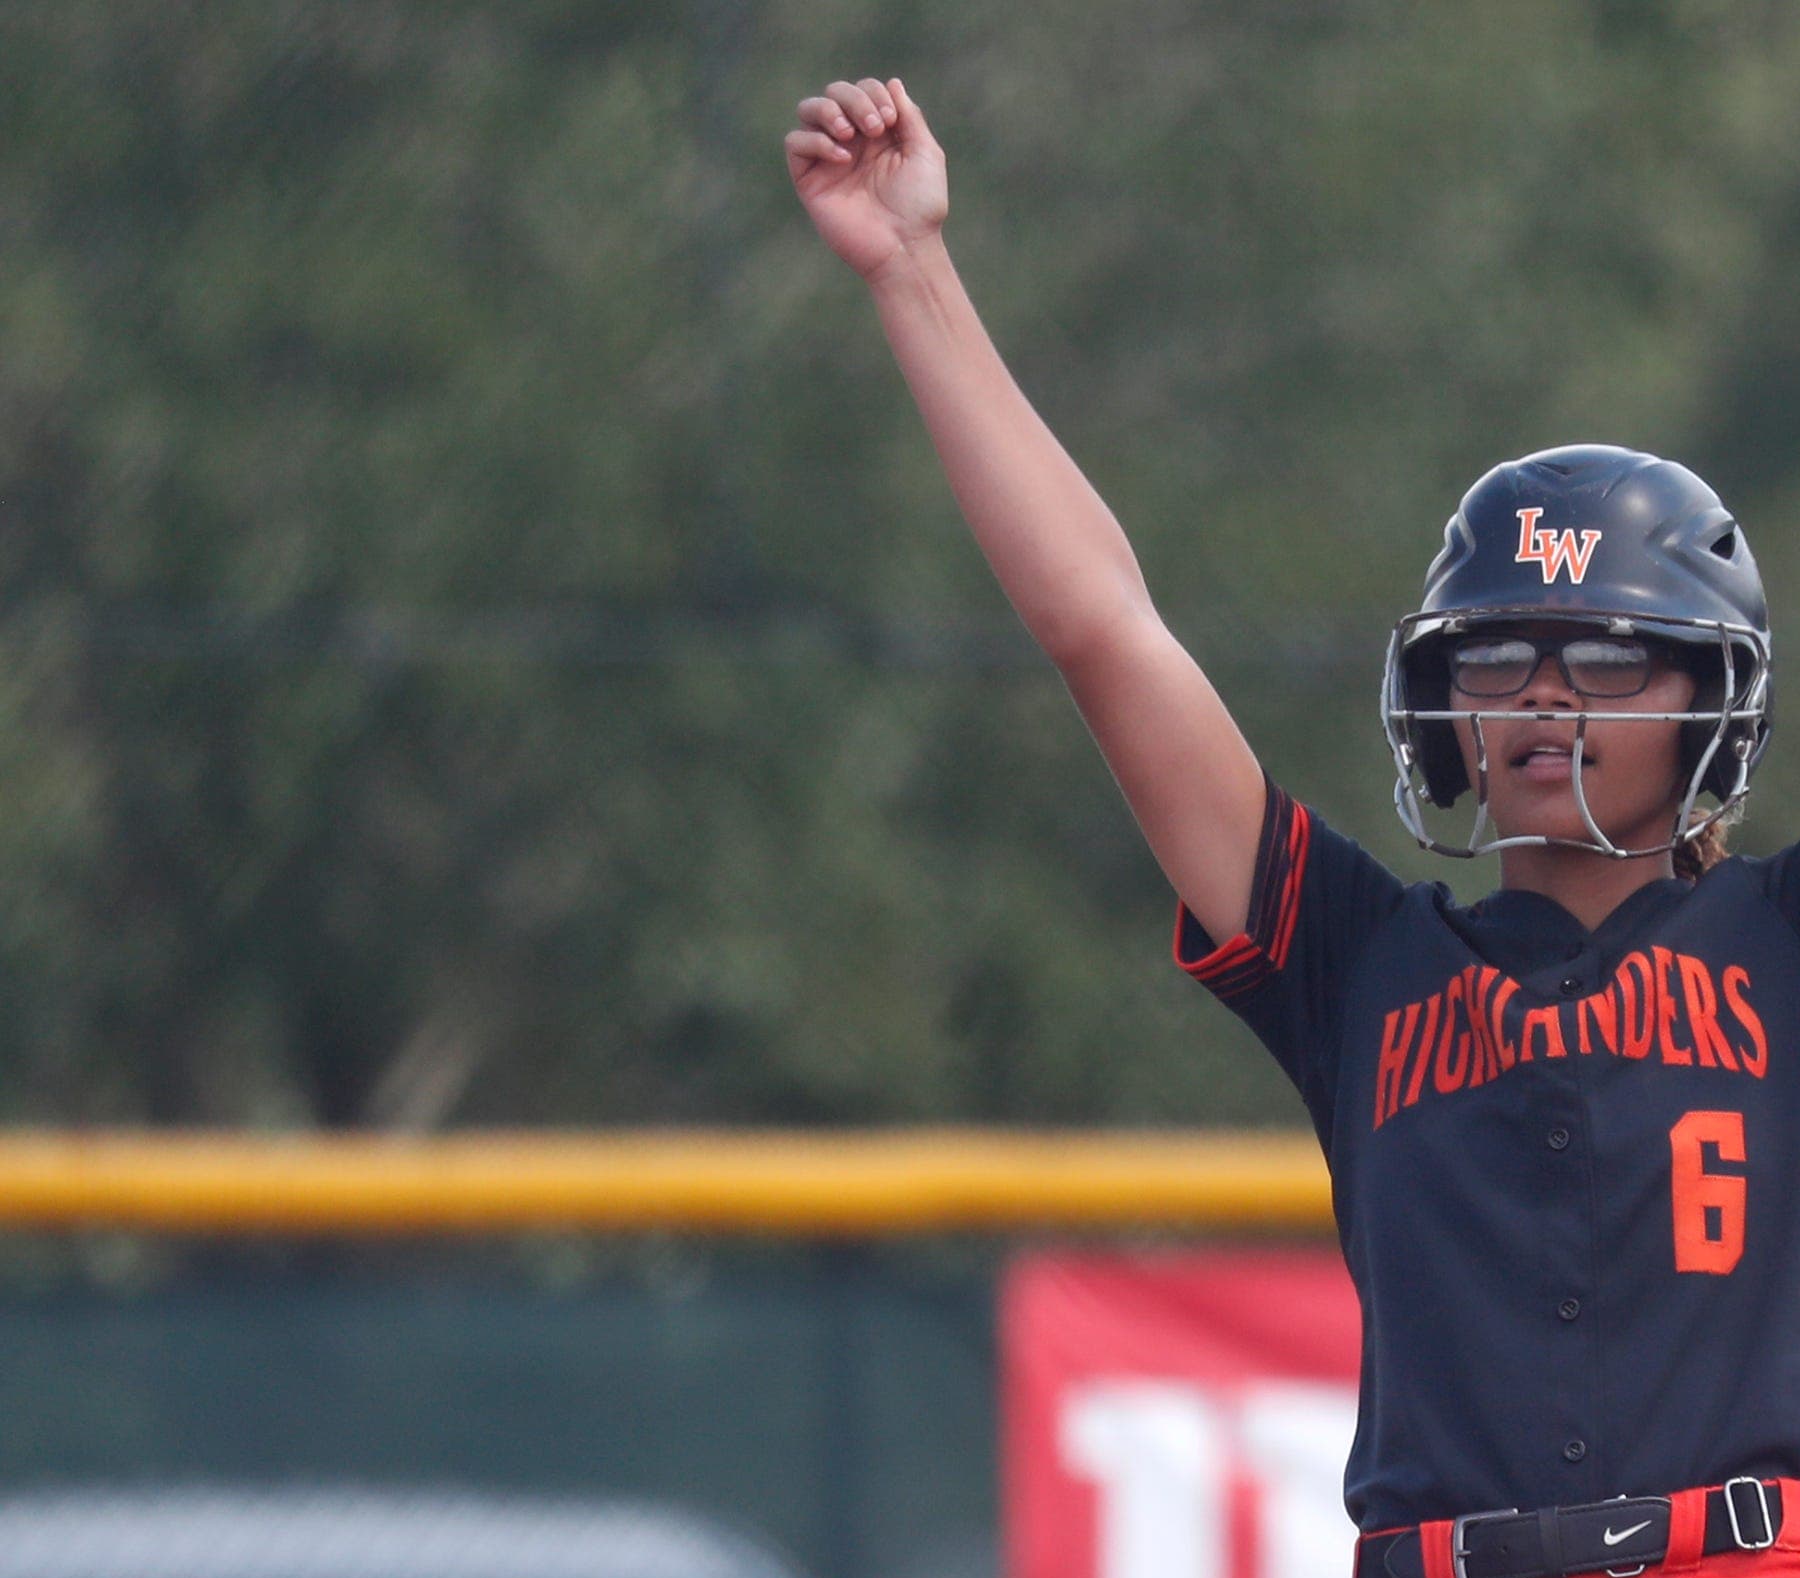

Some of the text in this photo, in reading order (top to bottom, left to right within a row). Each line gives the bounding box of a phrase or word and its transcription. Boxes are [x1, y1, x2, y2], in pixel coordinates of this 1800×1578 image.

[1515, 507, 1601, 584] LW
[1373, 945, 1768, 1131] HIGHLANDERS
[1669, 1110, 1747, 1276] 6
